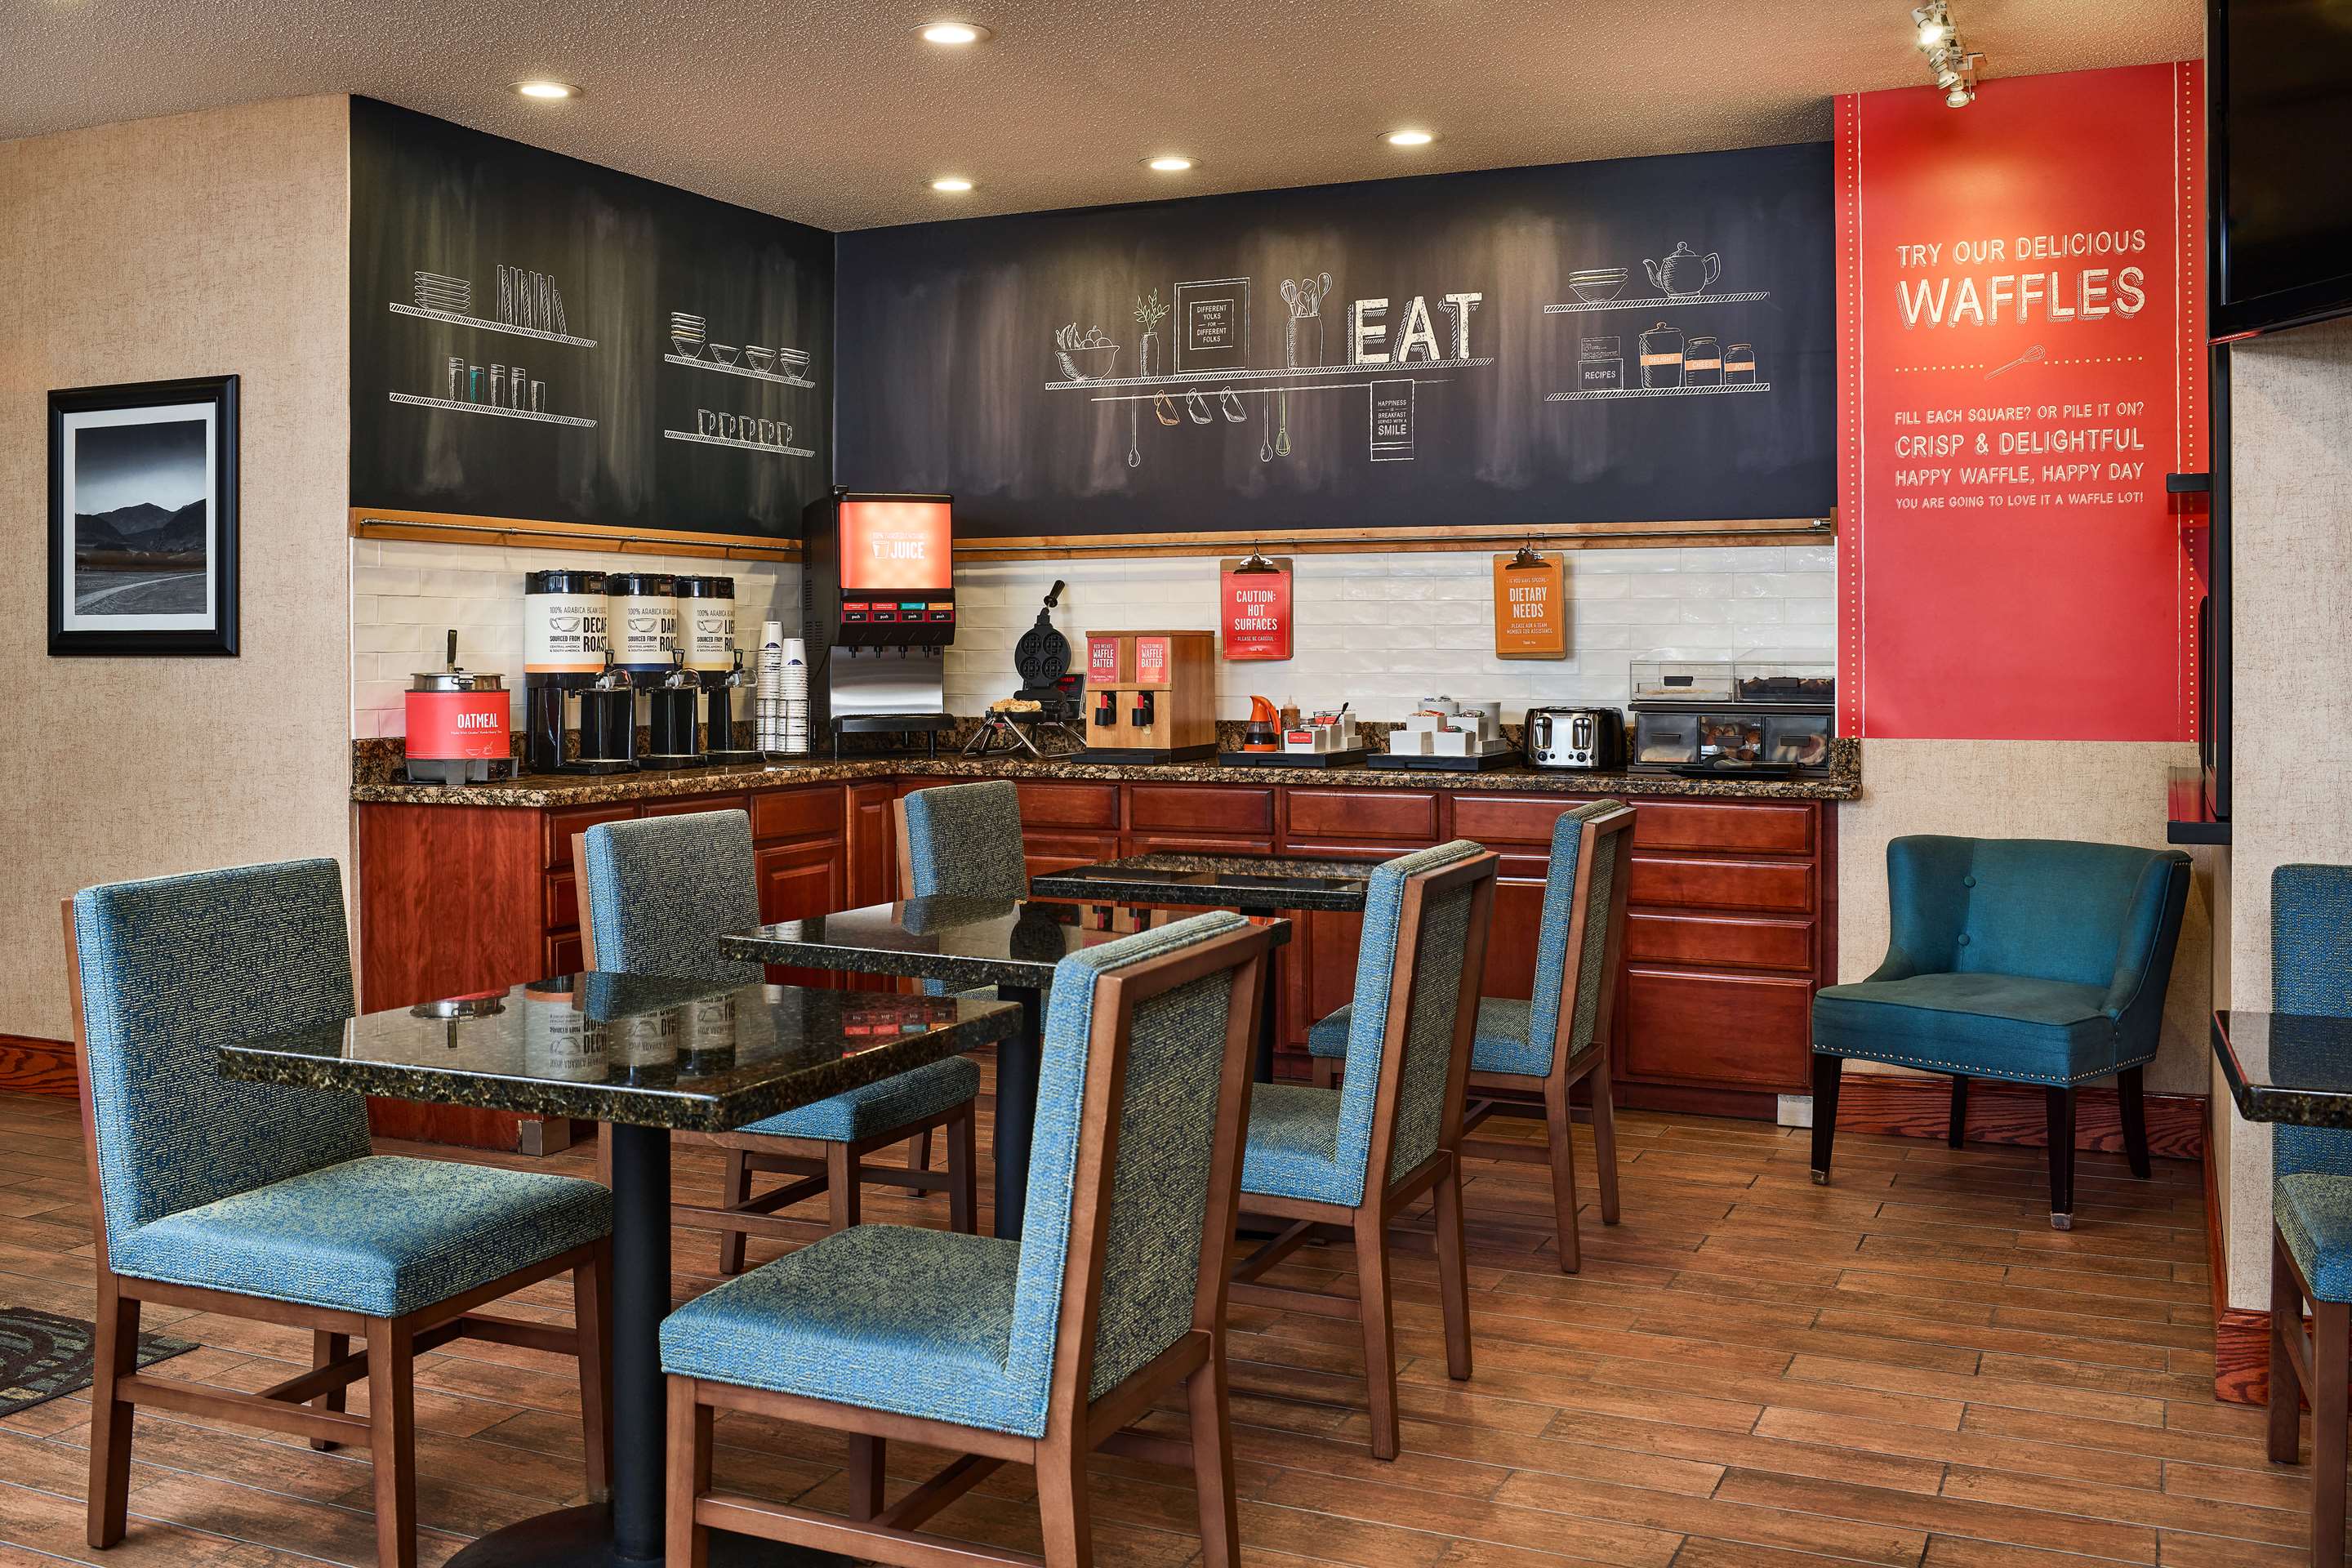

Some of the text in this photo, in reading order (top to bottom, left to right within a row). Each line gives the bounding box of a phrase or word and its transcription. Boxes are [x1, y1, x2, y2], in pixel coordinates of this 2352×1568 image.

[1895, 229, 2146, 268] TRY OUR DELICIOUS
[1895, 266, 2146, 331] WAFFLES
[1196, 305, 1227, 313] DIFFERENT
[1196, 327, 1227, 336] DIFFERENT
[1348, 292, 1482, 365] EAT
[1585, 370, 1616, 379] RECIPES
[1895, 401, 2144, 425] FILL EACH SQUARE? OR PILE IT ON?
[1378, 424, 1407, 436] SMILE
[1895, 427, 2145, 458] CRISP & DELIGHTFUL
[1895, 462, 2144, 487] HAPPY WAFFLE, HAPPY DAY
[1895, 491, 2144, 510] YOU ARE GOING TO LOVE IT A WAFFLE LOT!
[890, 541, 924, 559] JUICE
[1236, 590, 1276, 603] CAUTION:
[1509, 586, 1547, 601] DIETARY
[564, 606, 586, 614] ARABICA
[1248, 604, 1265, 616] HOT
[1513, 604, 1544, 618] NEEDS
[1235, 618, 1277, 630] SURFACES
[1093, 649, 1114, 658] WAFFLE
[1141, 648, 1163, 658] WAFFLE
[1093, 658, 1114, 668] BATTER
[1141, 658, 1163, 668] BATTER
[457, 713, 498, 728] OATMEAL
